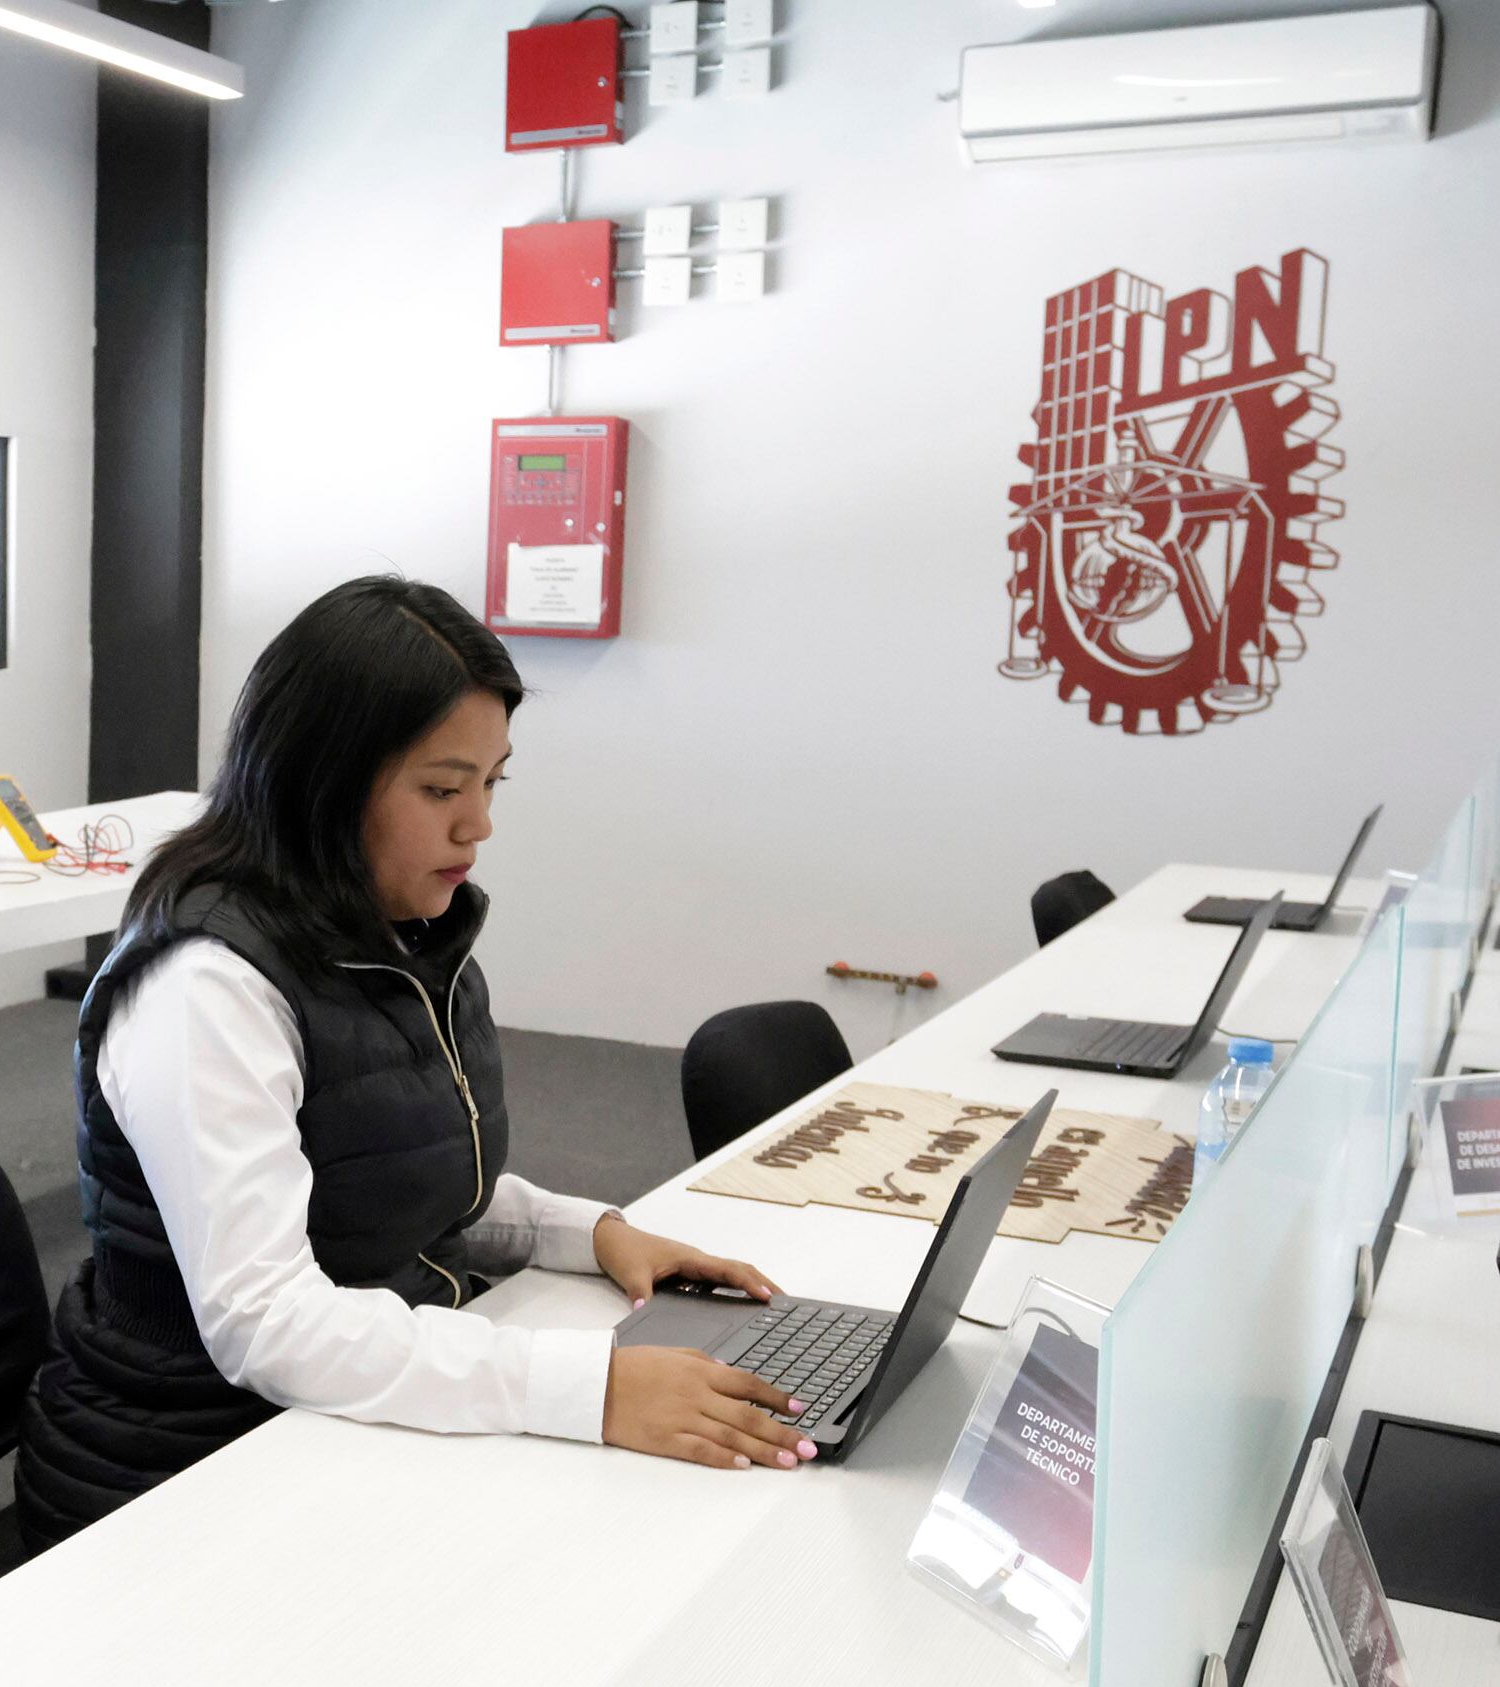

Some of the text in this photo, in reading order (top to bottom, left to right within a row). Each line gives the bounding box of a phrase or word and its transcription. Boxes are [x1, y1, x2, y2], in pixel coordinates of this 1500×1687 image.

[1120, 247, 1329, 407] IPN
[1459, 1144, 1474, 1156] DE
[1456, 1158, 1471, 1170] DE
[1021, 1425, 1040, 1444] DE
[1026, 1446, 1080, 1485] TÉCNICO
